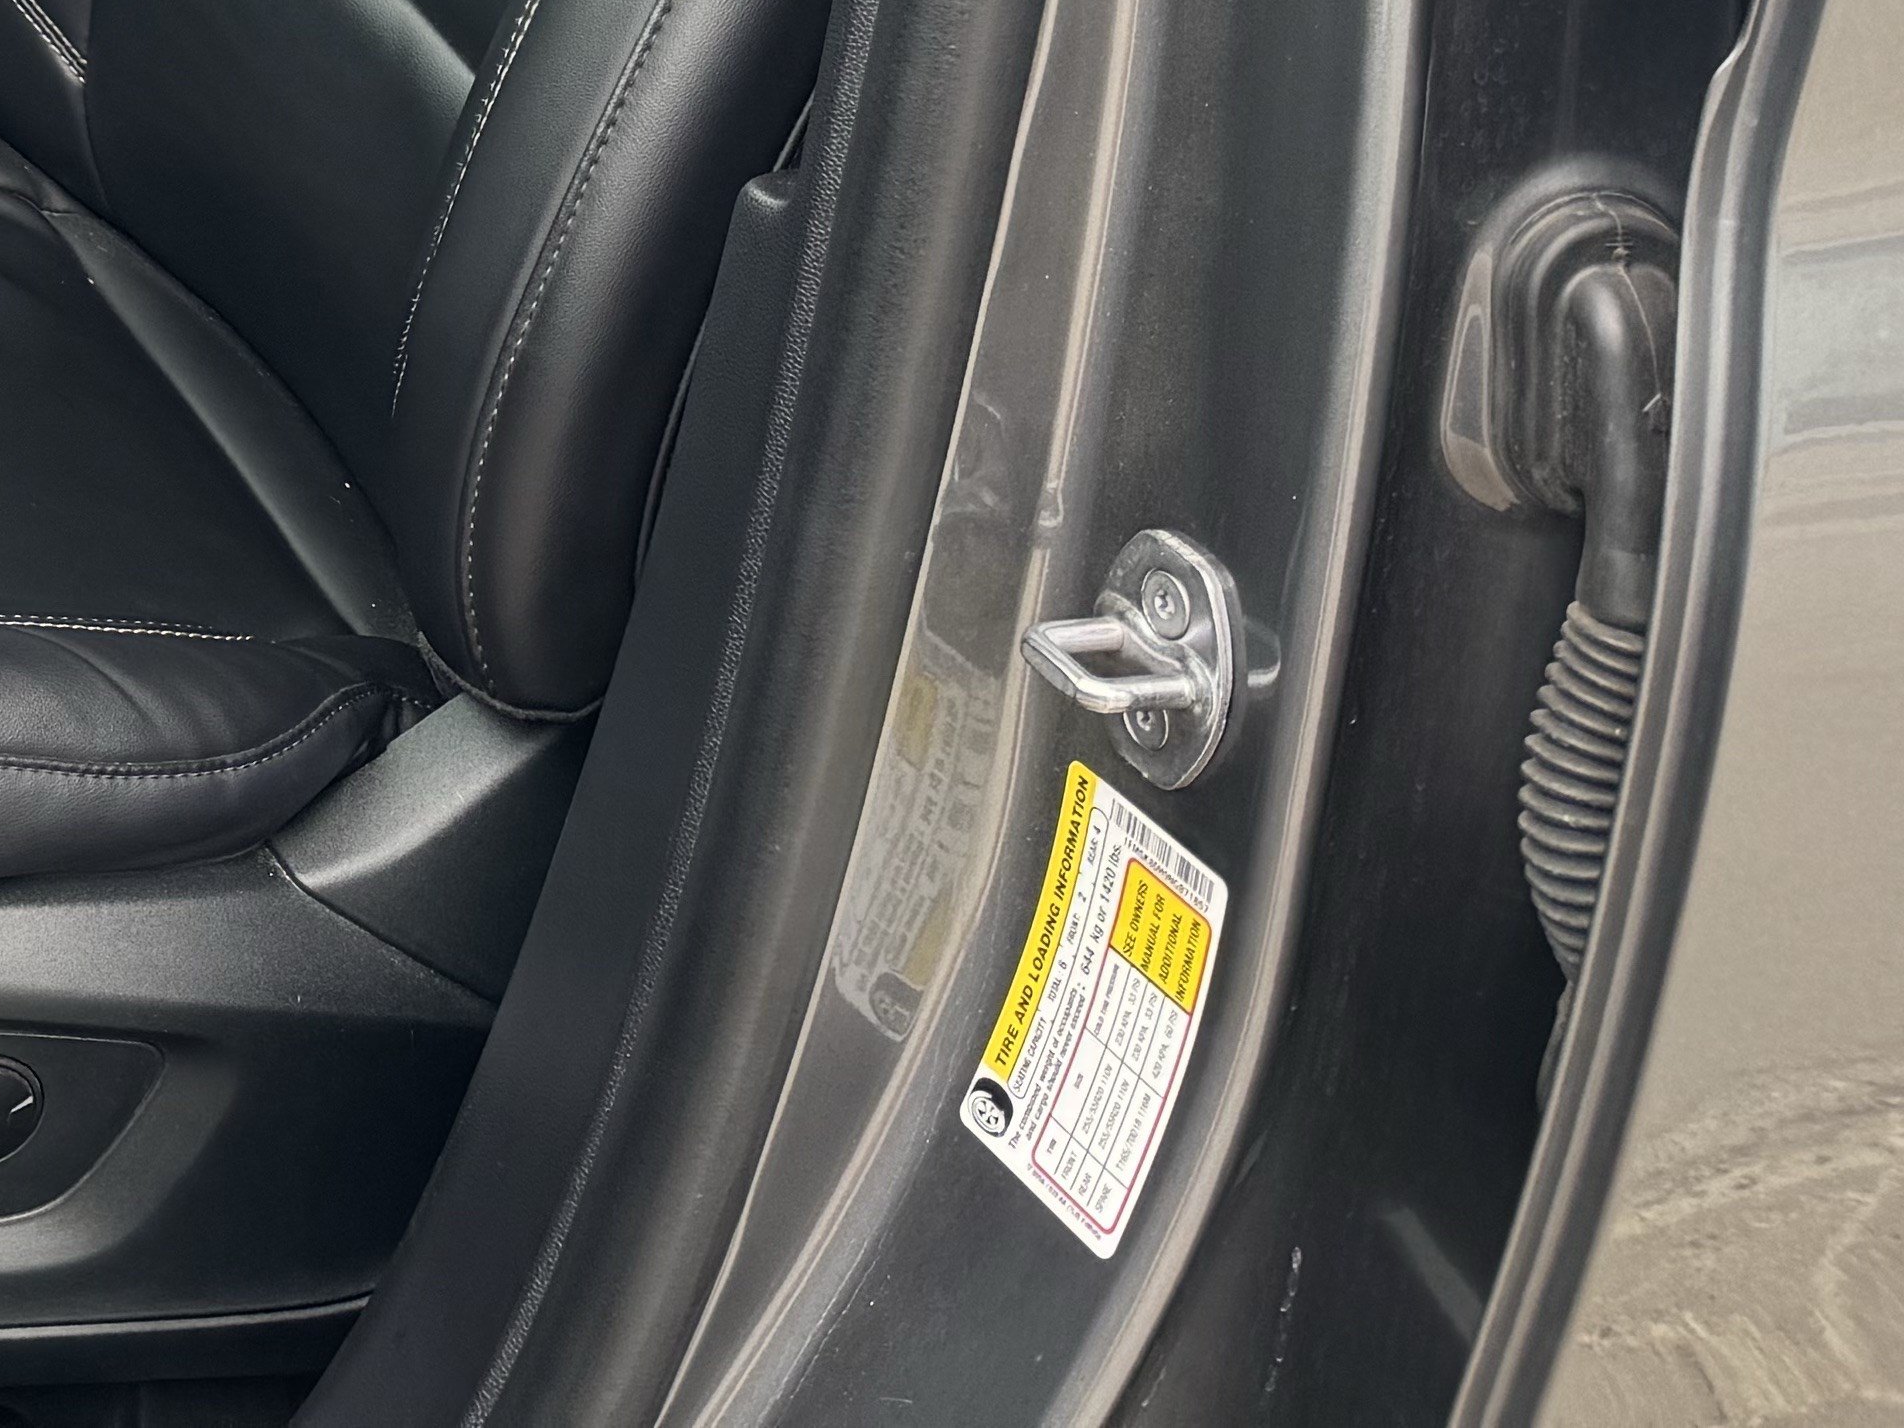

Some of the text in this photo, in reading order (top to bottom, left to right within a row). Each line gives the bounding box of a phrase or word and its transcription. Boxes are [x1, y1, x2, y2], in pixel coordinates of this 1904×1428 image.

[994, 774, 1089, 1069] TIRE AND LOADING INFORMATION
[1097, 905, 1106, 923] or
[1099, 865, 1115, 904] 1420
[1122, 878, 1148, 958] SEE OWNERS
[1080, 945, 1094, 976] 644
[1089, 923, 1104, 943] kg
[1140, 892, 1165, 973] MANUAL FOR
[1157, 909, 1182, 984] ADDITIONAL
[1174, 917, 1201, 1003] INFORMATION
[1012, 1056, 1031, 1093] SEATING
[1027, 1016, 1046, 1058] CAPACITY
